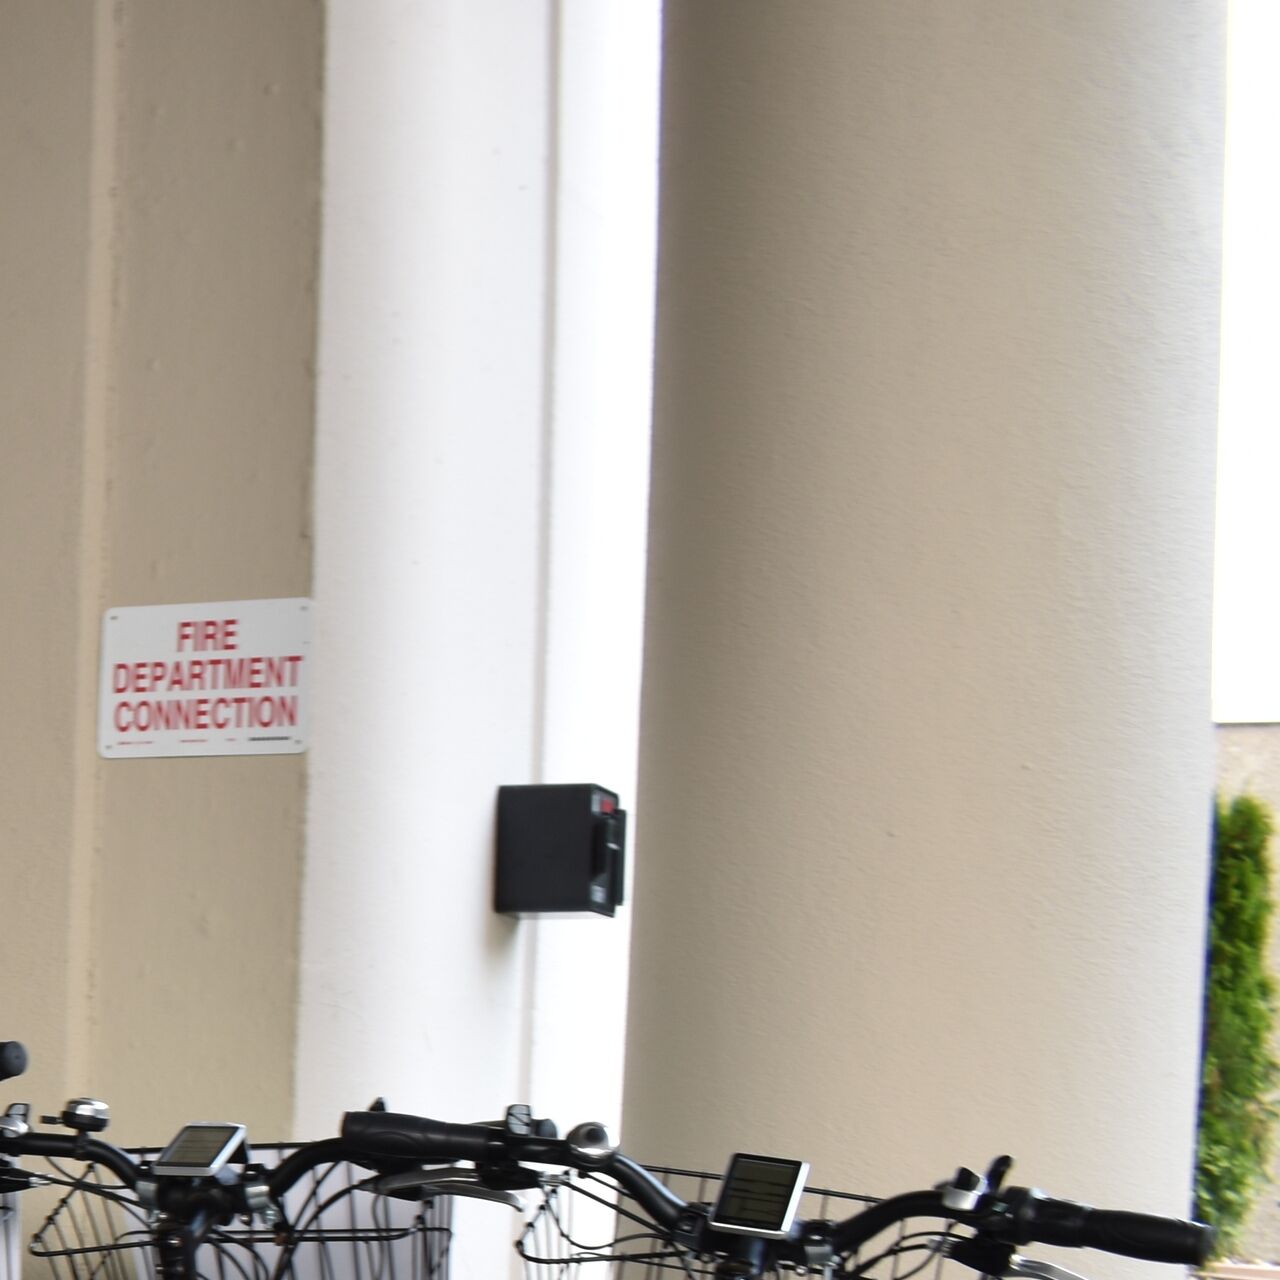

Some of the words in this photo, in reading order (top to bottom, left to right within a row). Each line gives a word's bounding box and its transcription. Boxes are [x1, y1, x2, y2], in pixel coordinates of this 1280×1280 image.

[177, 618, 238, 652] FIRE
[112, 655, 304, 693] DEPARTMENT
[112, 695, 298, 732] CONNECTION
